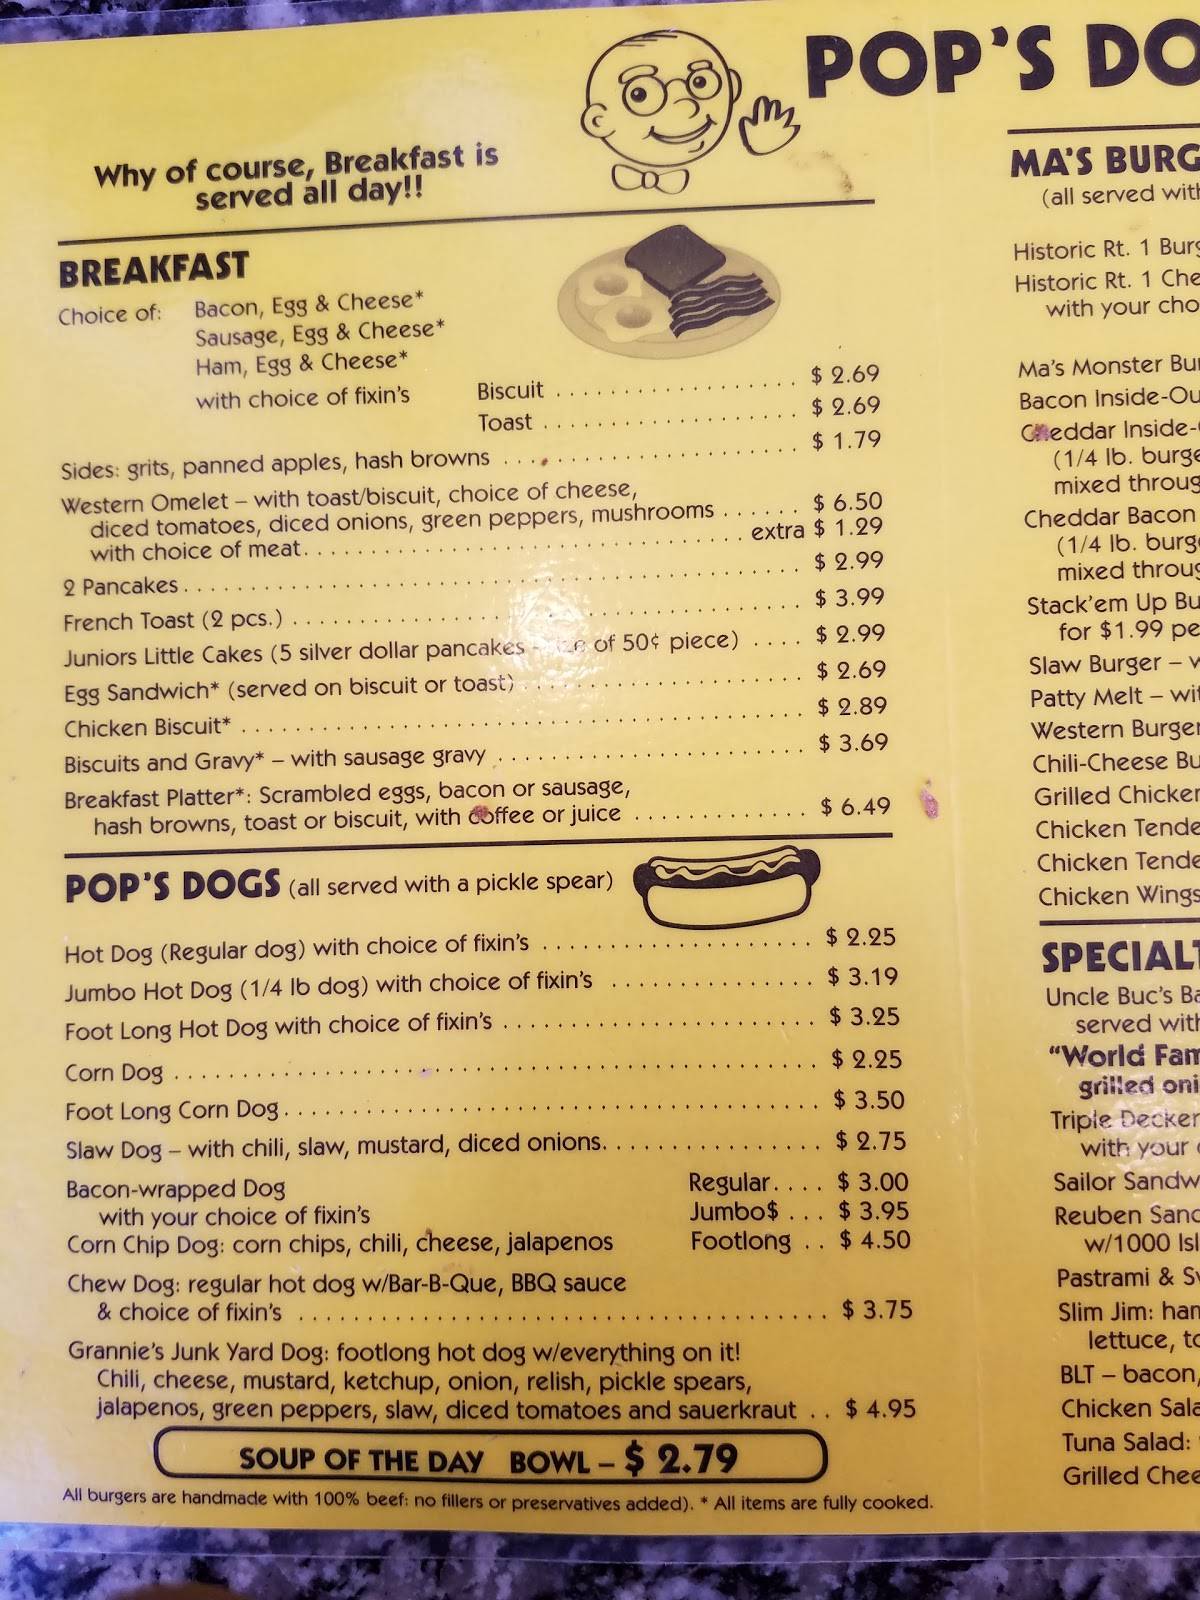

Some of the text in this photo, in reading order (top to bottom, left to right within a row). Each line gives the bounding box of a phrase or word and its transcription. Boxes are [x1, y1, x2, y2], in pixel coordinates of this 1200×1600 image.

[805, 18, 1200, 99] POP'S DO
[93, 141, 499, 192] Why of course, Breakfast is
[1010, 146, 1093, 178] MA'S
[195, 173, 423, 212] served all day!!
[1014, 238, 1149, 262] Historic Rt. 1
[59, 250, 250, 289] BREAKFAST
[58, 303, 161, 326] Choice of:
[195, 301, 264, 320] Bacon,
[272, 296, 308, 318] Egg
[315, 294, 330, 313] &
[1045, 298, 1094, 318] with
[1100, 300, 1151, 320] your
[1018, 356, 1164, 378] Ma's Monster
[477, 380, 544, 401] Biscuit
[831, 364, 880, 385] 2.69
[196, 385, 410, 410] with choice of fixin's
[61, 461, 119, 481] Sides:
[127, 458, 175, 482] grits,
[183, 454, 264, 479] panned
[271, 452, 347, 476] apples,
[355, 450, 403, 470] hash
[410, 449, 490, 469] browns
[833, 429, 881, 450] 1.79
[63, 578, 76, 597] 2
[83, 576, 179, 596] Pancakes
[834, 550, 884, 571] 2.99
[64, 612, 133, 632] French
[140, 611, 195, 630] Toast
[202, 609, 224, 631] (2
[231, 608, 282, 632] pcs.)
[835, 586, 885, 608] 3.99
[65, 685, 100, 707] Egg
[228, 678, 307, 702] (served
[314, 682, 342, 696] on
[349, 676, 418, 696] biscuit
[424, 679, 448, 694] or
[453, 672, 514, 694] toast)
[1030, 721, 1124, 741] Western
[1034, 785, 1111, 807] Grilled
[94, 816, 142, 836] hash
[150, 815, 236, 837] browns,
[243, 813, 298, 832] toast
[304, 815, 327, 830] or
[334, 809, 408, 831] biscuit,
[414, 807, 461, 826] with
[542, 808, 566, 824] or
[569, 803, 621, 827] juice
[841, 796, 891, 816] 6.49
[1035, 819, 1126, 840] Chicken
[65, 867, 613, 904] POP'S DOGS (all served with a pickle spear)
[1046, 985, 1173, 1007] Uncle Buc's
[689, 1171, 771, 1197] Regular
[858, 1171, 909, 1192] 3.00
[1053, 1171, 1117, 1192] Sailor
[690, 1199, 779, 1222] Jumbo$
[859, 1200, 909, 1221] 3.95
[67, 1228, 614, 1259] Corn Chip Dog: corn chips, chili, cheese, jalapenos
[691, 1230, 792, 1255] Footlong
[860, 1229, 911, 1250] 4.50
[1084, 1232, 1171, 1254] w/1000
[1057, 1266, 1175, 1288] Pastrami &
[1058, 1301, 1153, 1322] Slim Jim:
[68, 1340, 740, 1367] Grannie's Junk Yard Dog: footlong hot dog w/everything on it!
[1061, 1364, 1095, 1384] BLT
[1061, 1398, 1152, 1419] Chicken
[1061, 1431, 1191, 1452] Tuna Salad:
[239, 1446, 316, 1471] SOUP
[324, 1448, 361, 1471] OF
[368, 1449, 419, 1473] THE
[428, 1450, 484, 1475] DAY
[510, 1450, 591, 1475] BOWL
[658, 1443, 738, 1473] 2.79
[62, 1487, 82, 1502] All
[87, 1487, 147, 1506] burgers
[151, 1492, 177, 1505] are
[182, 1489, 268, 1507] handmade
[272, 1490, 308, 1506] with
[314, 1491, 360, 1507] 100%
[414, 1496, 437, 1508] no
[441, 1493, 484, 1509] fillers
[488, 1498, 507, 1509] or
[512, 1496, 621, 1512] preservatives
[713, 1495, 735, 1511] All
[741, 1495, 786, 1511] items
[790, 1498, 818, 1511] are
[823, 1494, 858, 1513] fully
[862, 1494, 933, 1511] cooked.
